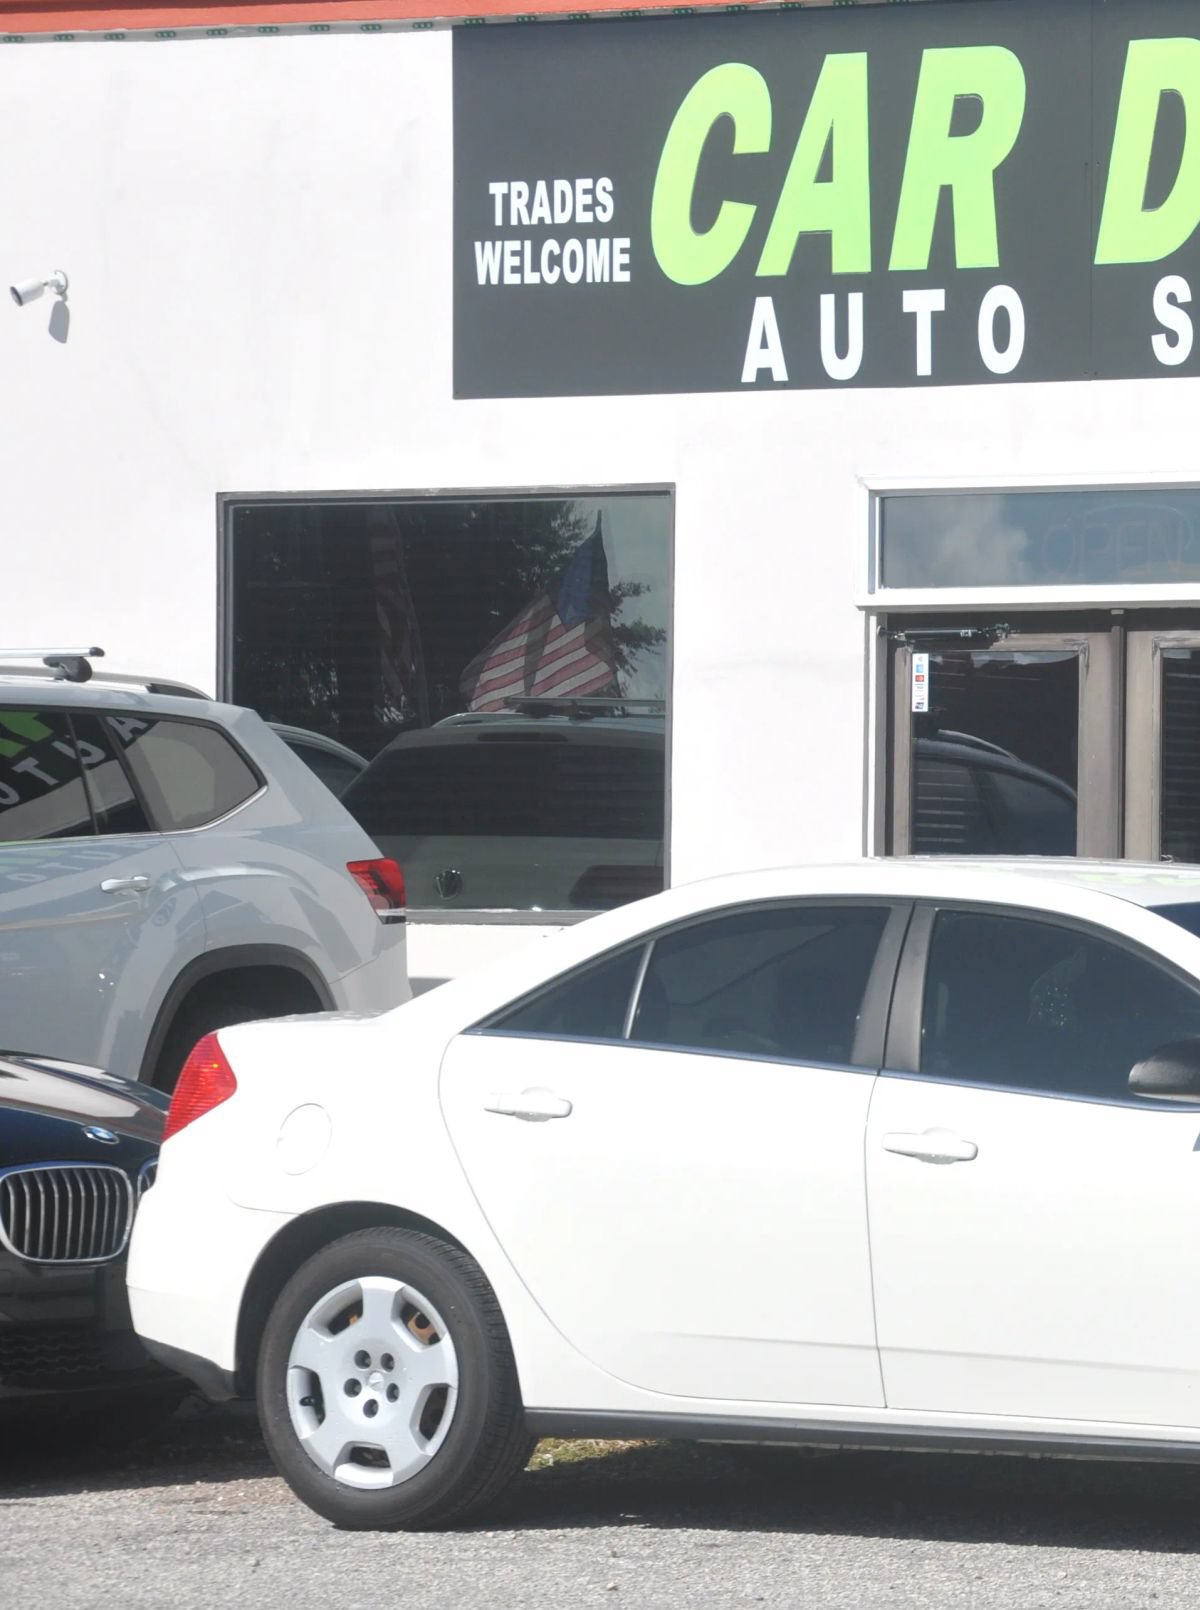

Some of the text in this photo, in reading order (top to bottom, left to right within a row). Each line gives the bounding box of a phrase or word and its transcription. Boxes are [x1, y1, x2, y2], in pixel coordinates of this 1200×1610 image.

[651, 45, 1026, 286] CAR
[489, 177, 614, 226] TRADES
[474, 237, 631, 285] WELCOME
[741, 284, 1026, 383] AUTO
[1040, 518, 1186, 577] OPEN
